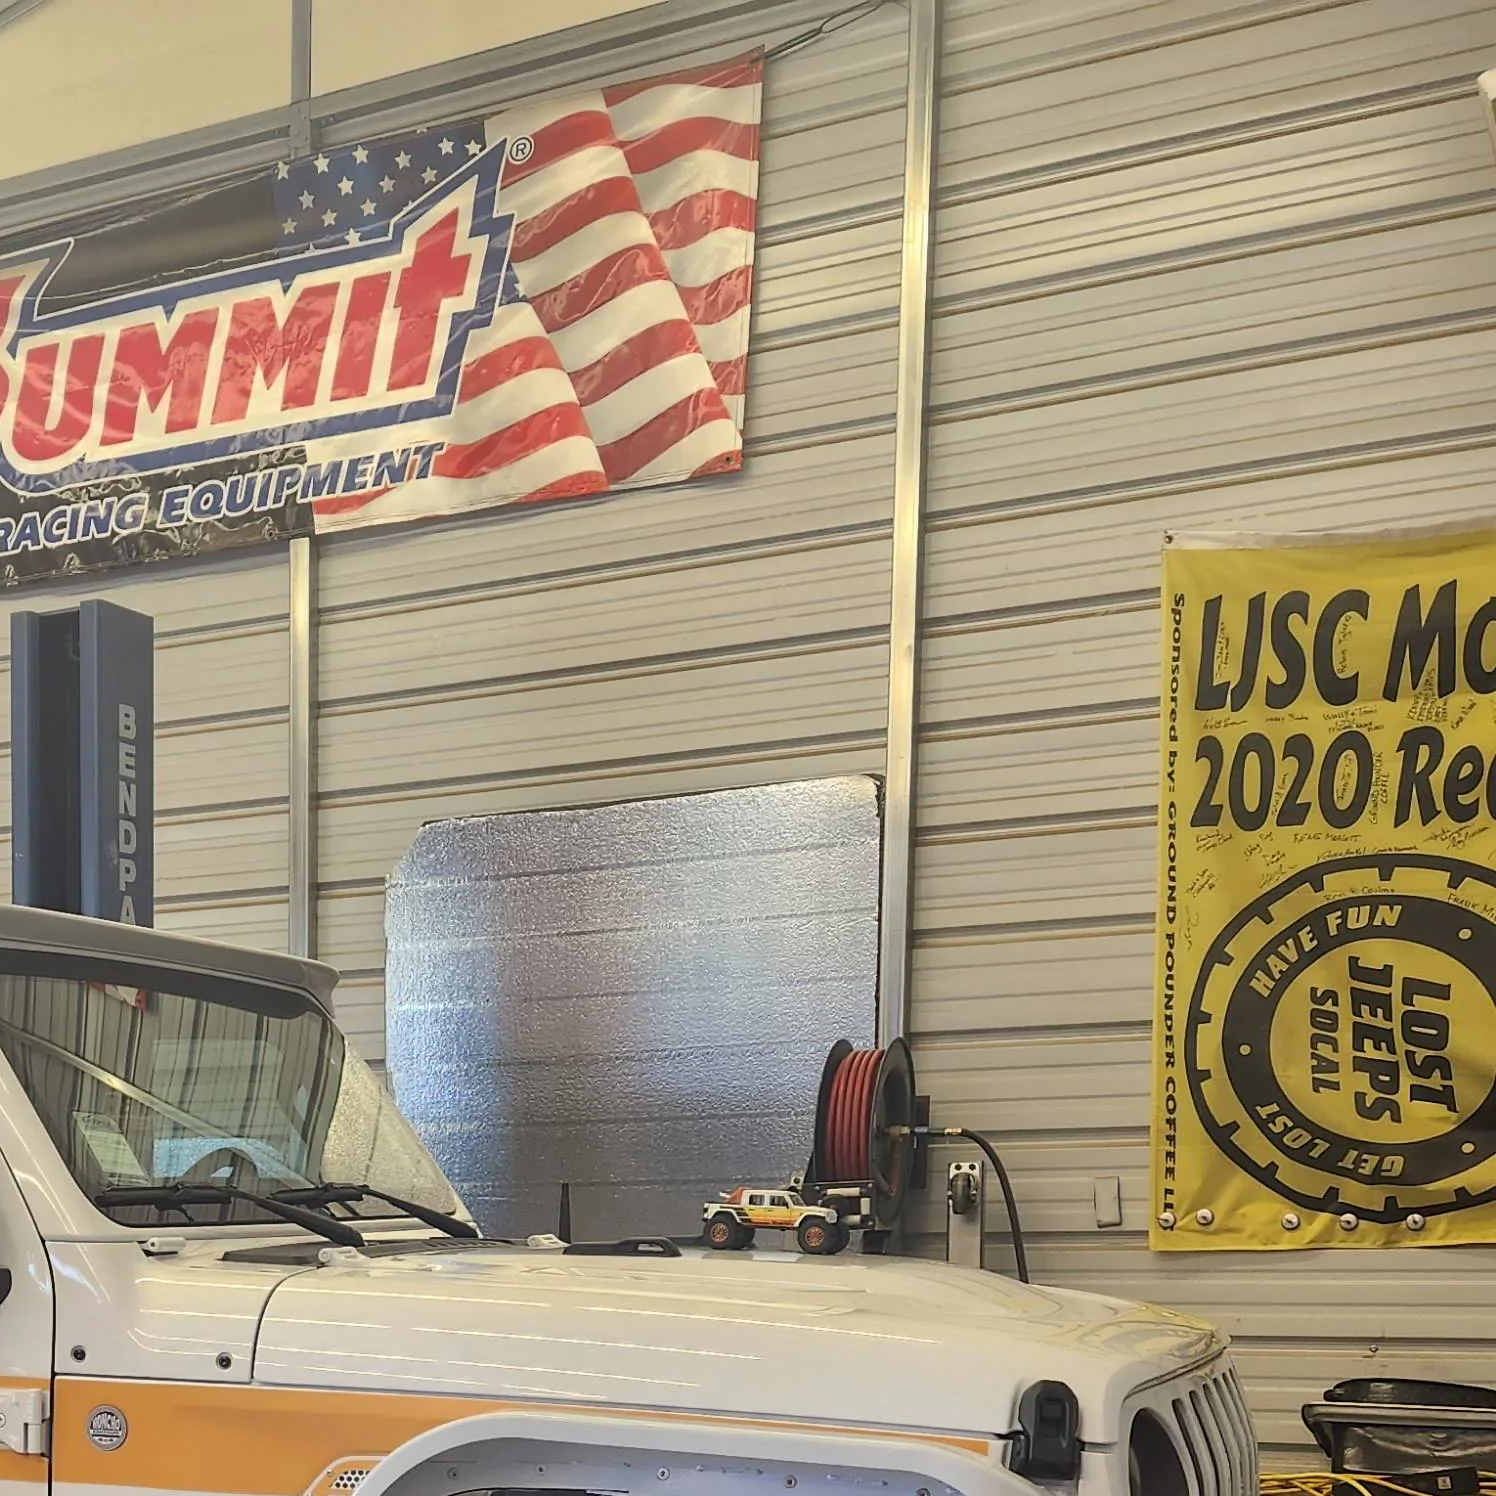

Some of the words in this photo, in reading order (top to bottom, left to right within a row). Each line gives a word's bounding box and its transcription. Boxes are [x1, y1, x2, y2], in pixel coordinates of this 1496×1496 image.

[157, 441, 448, 528] EQUIPMENT
[1168, 593, 1185, 743] Sponsored
[1194, 588, 1370, 713] LJSC
[1168, 750, 1178, 793] by:
[1190, 730, 1374, 831] 2020
[1166, 800, 1178, 925] GROUND
[1164, 932, 1177, 1068] POUNDER
[1249, 925, 1319, 999] HAVE
[1326, 905, 1402, 937] FUN
[1310, 986, 1341, 1094] SOCAL
[1348, 956, 1401, 1124] JEEPS
[1401, 976, 1459, 1114] LOST
[1163, 1075, 1177, 1181] COFFEE
[1255, 1102, 1331, 1159] LOST
[1337, 1149, 1406, 1177] GET
